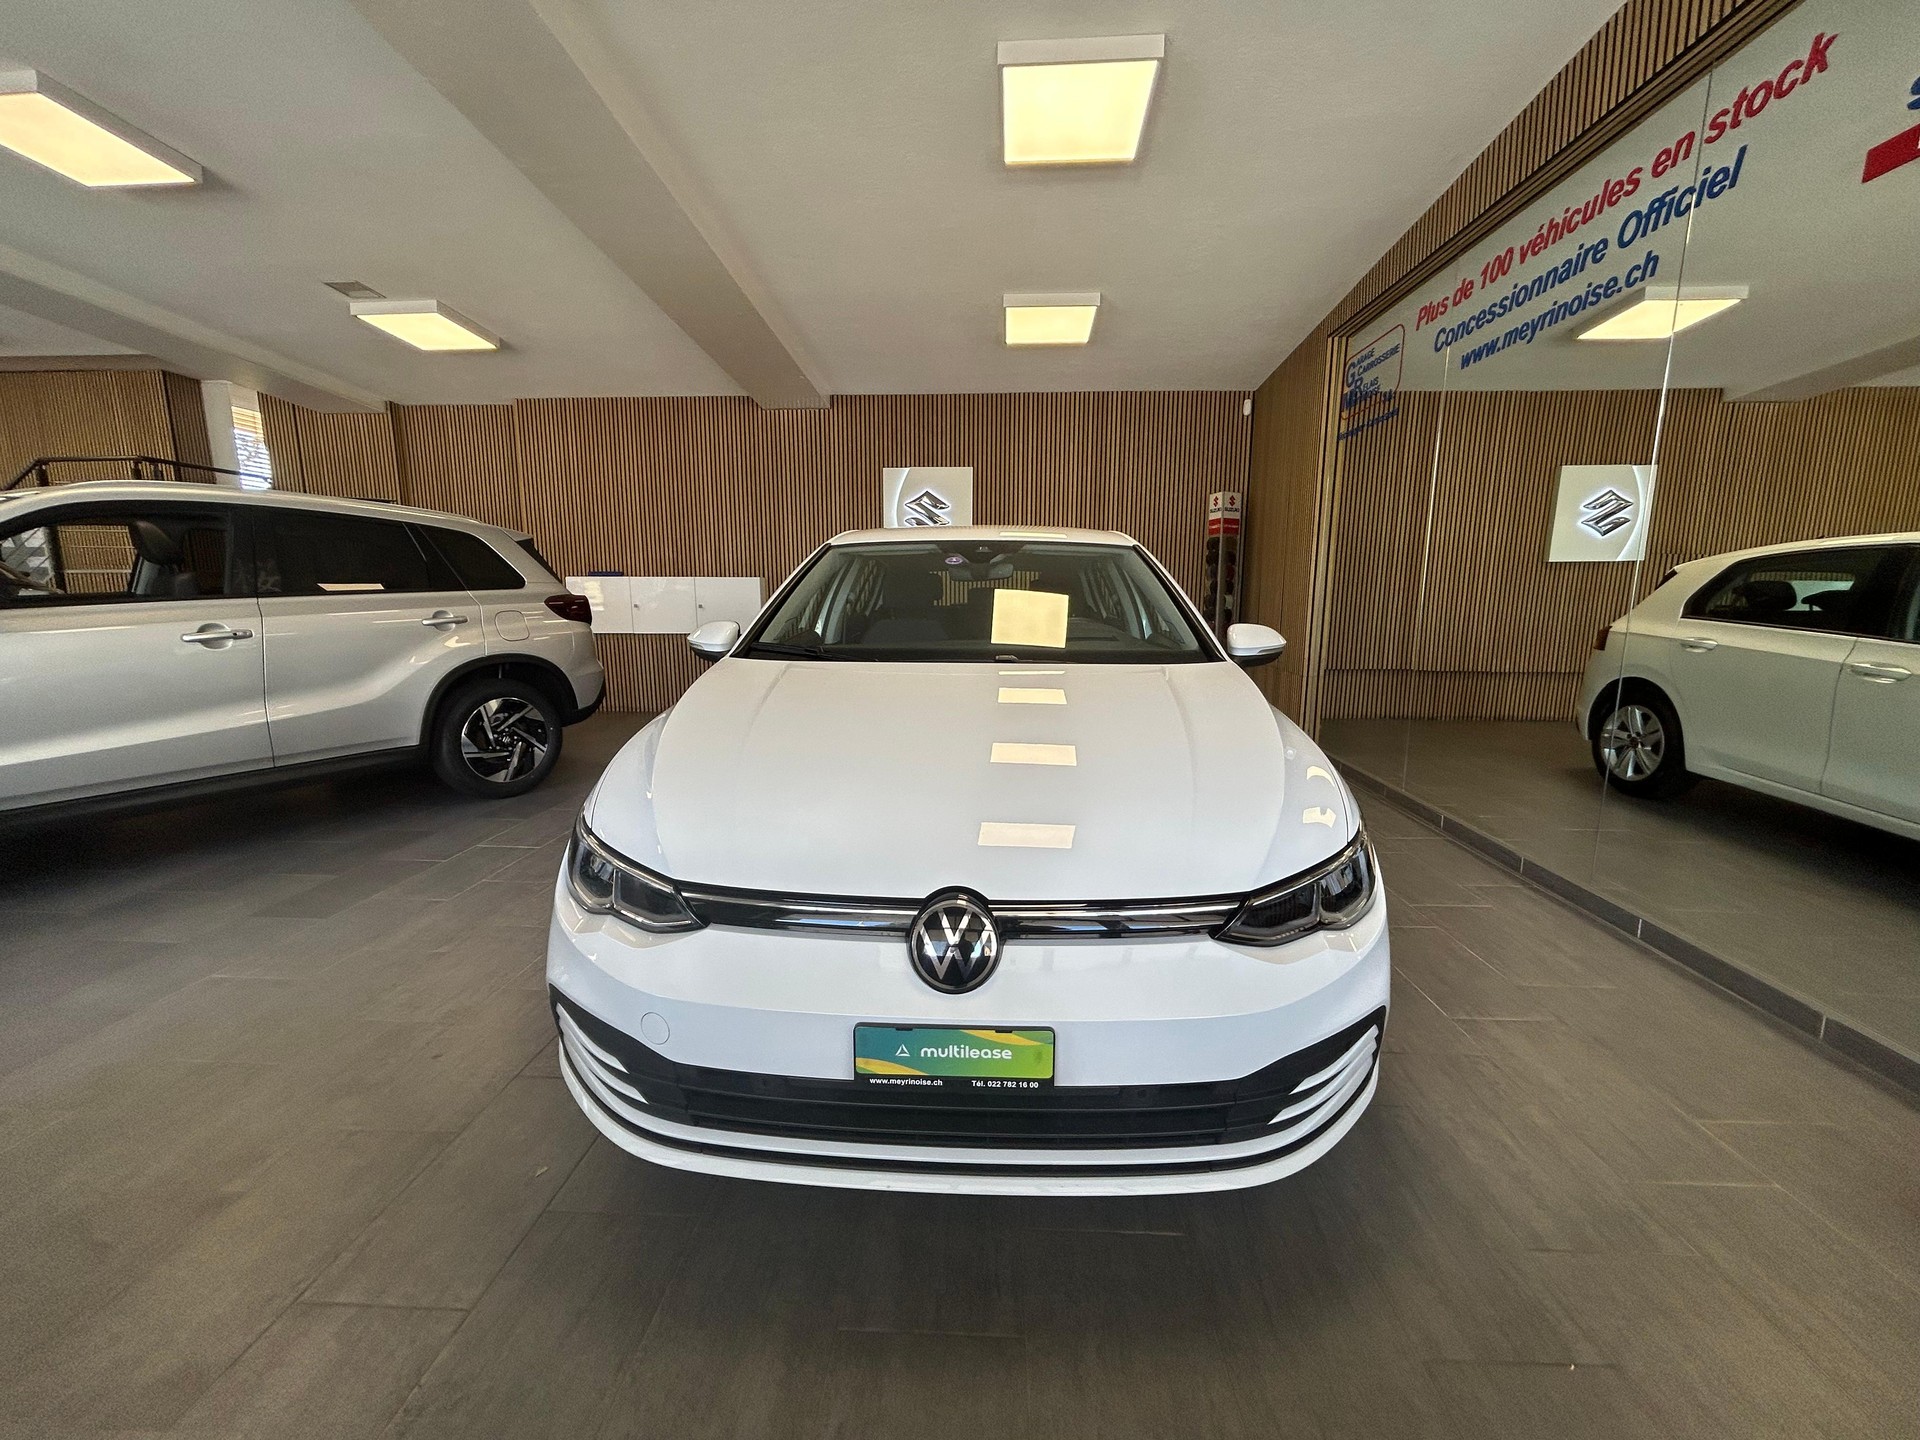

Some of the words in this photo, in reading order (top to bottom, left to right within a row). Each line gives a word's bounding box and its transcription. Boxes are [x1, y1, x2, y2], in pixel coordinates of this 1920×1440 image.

[1415, 296, 1450, 332] Plus
[1452, 277, 1475, 307] de
[1480, 246, 1515, 290] 100
[1519, 166, 1643, 265] véhicules
[1651, 131, 1696, 178] en
[1704, 32, 1840, 144] stock
[1434, 237, 1609, 353] Concessionnaire
[1617, 144, 1749, 249] Officiel
[1460, 249, 1660, 370] www.meyrinoise.ch
[869, 1077, 943, 1086] www.meyrinoise.ch
[920, 1044, 1013, 1060] multilease
[987, 1080, 1001, 1088] 022
[1029, 1081, 1039, 1089] 00
